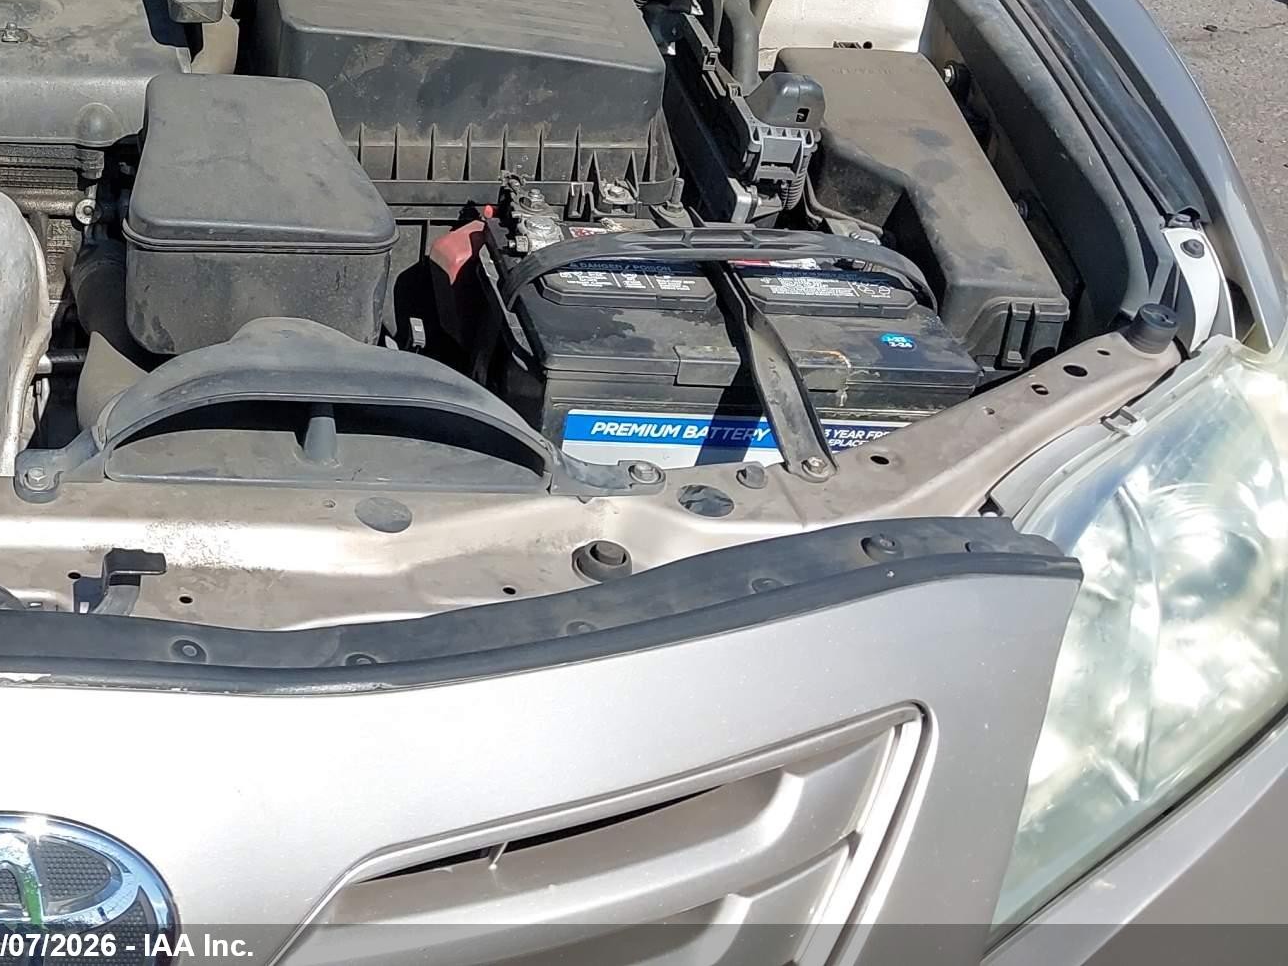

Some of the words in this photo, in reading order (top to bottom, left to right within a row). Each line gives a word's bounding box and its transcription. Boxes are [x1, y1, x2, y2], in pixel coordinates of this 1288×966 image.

[591, 421, 678, 438] PREMIUM
[682, 425, 770, 442] BATTERY
[833, 429, 865, 439] YEAR
